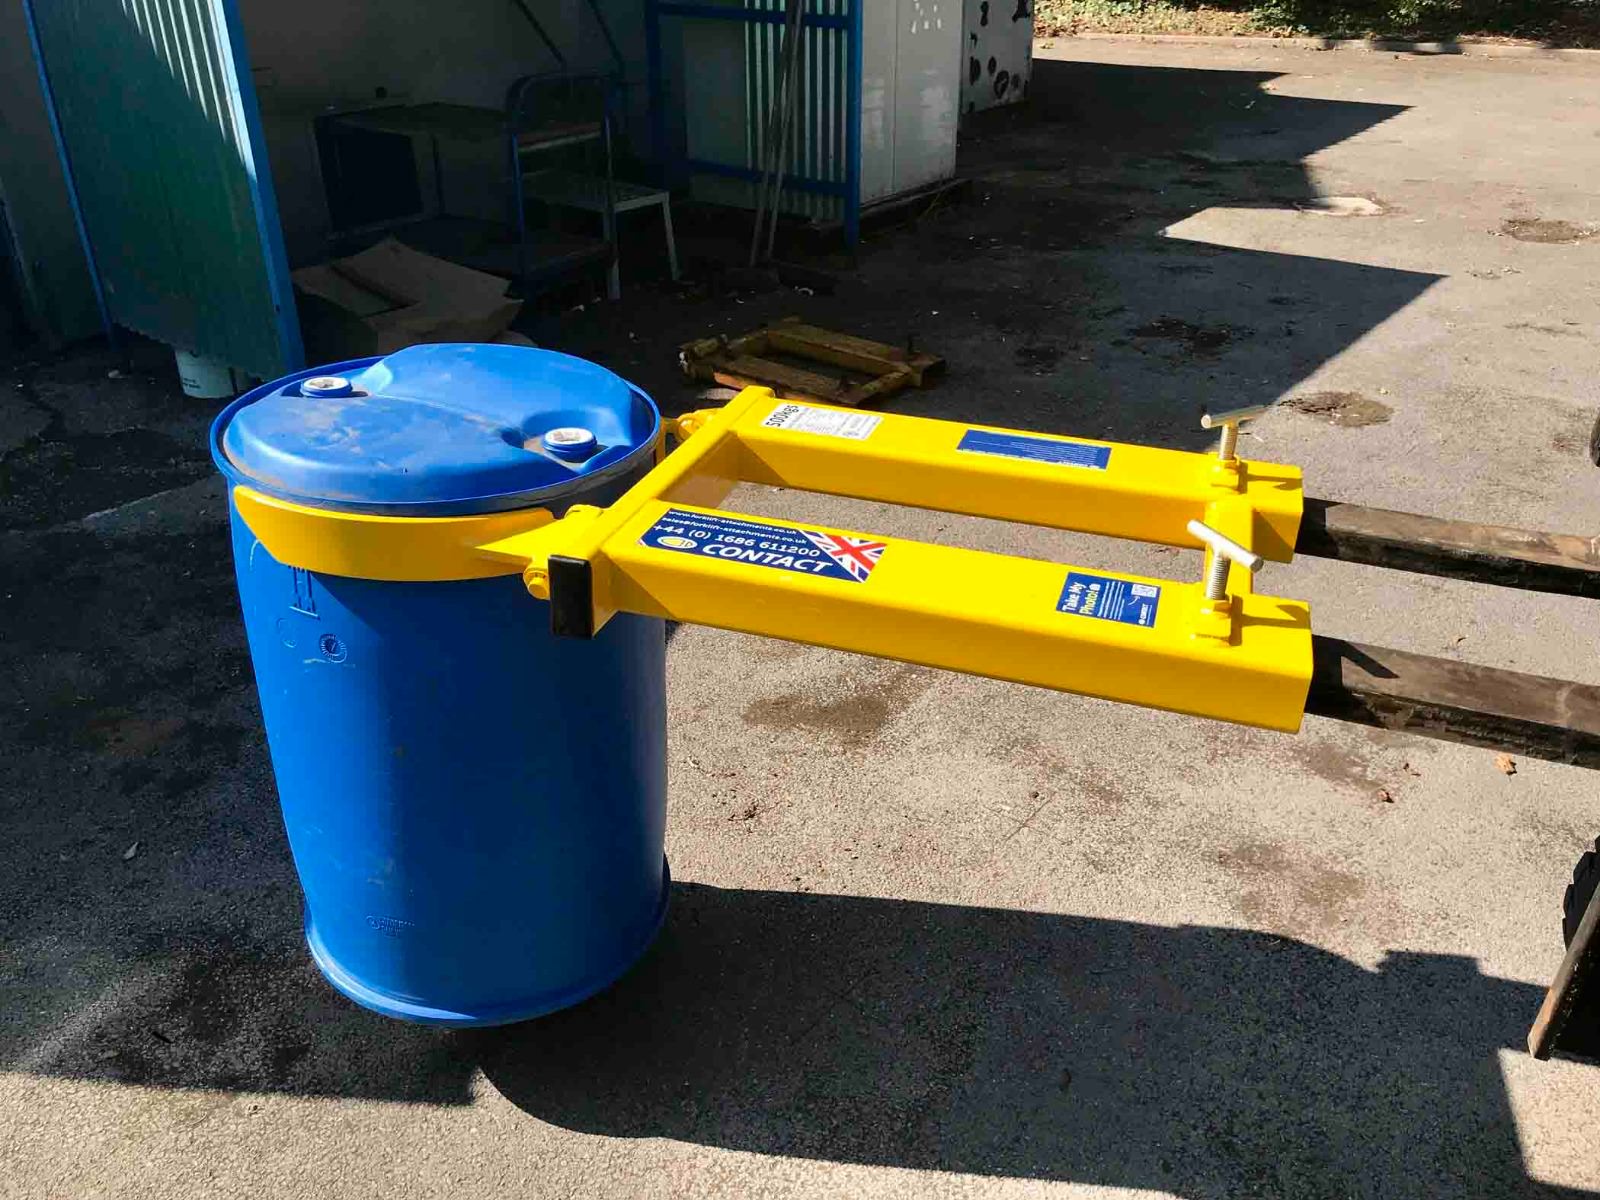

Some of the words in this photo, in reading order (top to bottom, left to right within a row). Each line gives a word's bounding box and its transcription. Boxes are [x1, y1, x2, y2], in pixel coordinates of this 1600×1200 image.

[661, 517, 807, 544] sales@forklift-attachments.co.uk
[668, 510, 797, 535] www.forklift-attachments.co.uk
[653, 525, 685, 534] +44
[688, 529, 711, 539] (0)
[715, 534, 756, 546] 1686
[759, 541, 821, 557] 611200
[702, 543, 834, 572] CONTACT
[1068, 582, 1087, 594] My
[1062, 593, 1080, 611] Take
